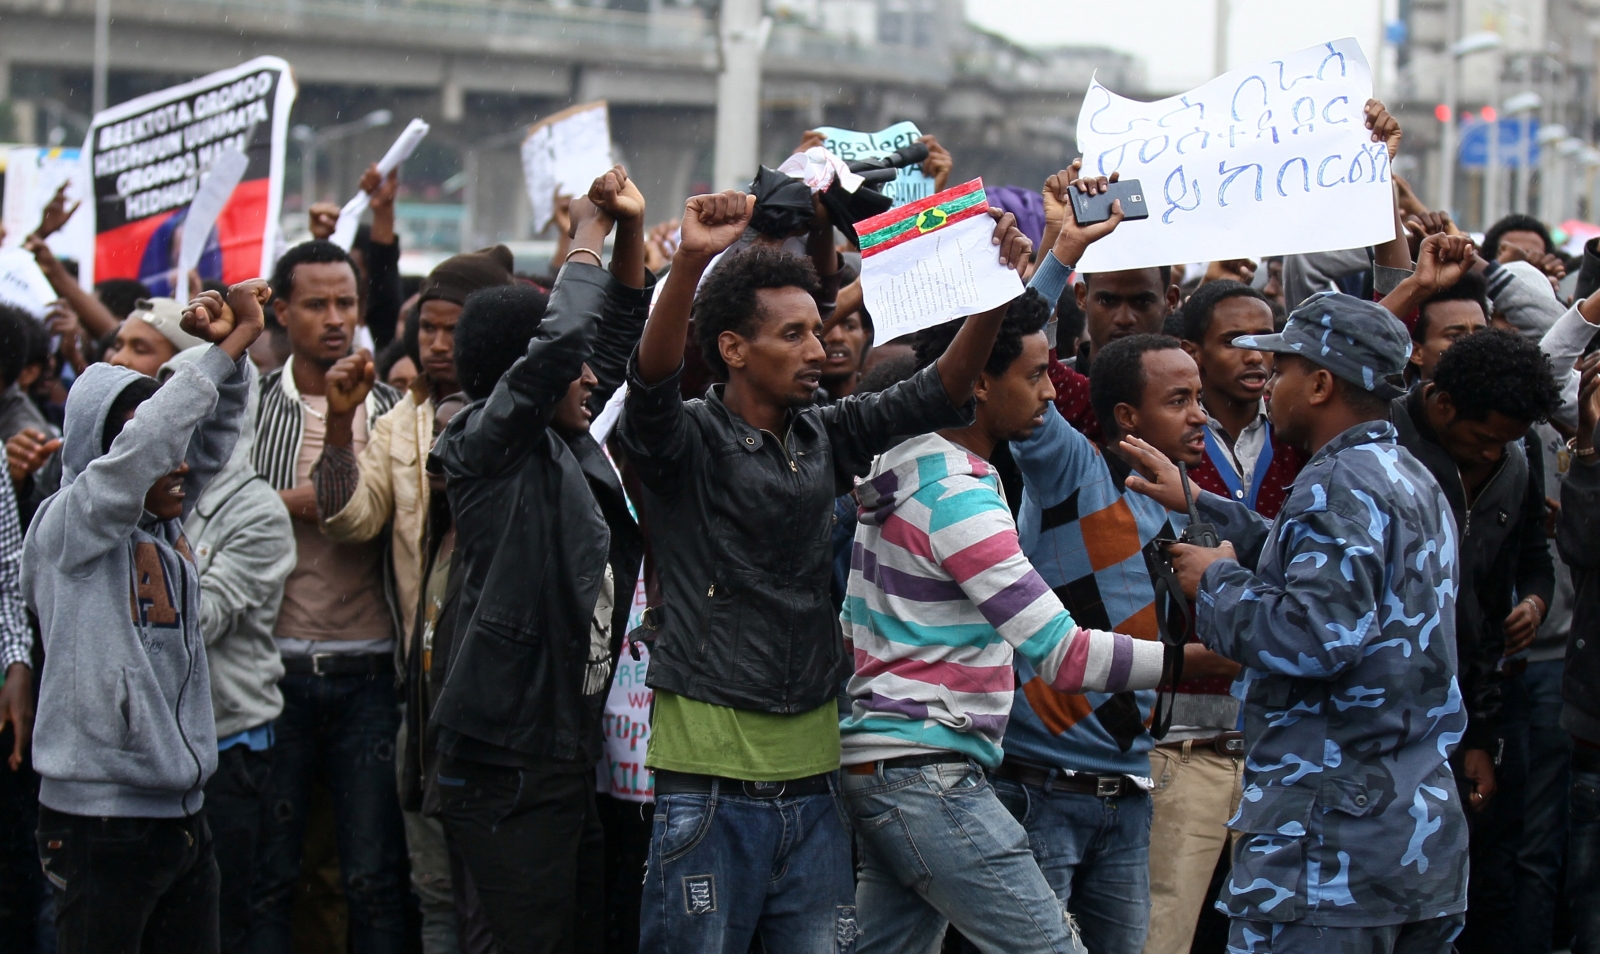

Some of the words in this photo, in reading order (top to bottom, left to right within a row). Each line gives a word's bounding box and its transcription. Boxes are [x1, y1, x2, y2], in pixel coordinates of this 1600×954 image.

[99, 101, 193, 152] BEEKTOTA
[193, 72, 272, 120] OROMOO
[614, 663, 647, 689] RE
[603, 713, 647, 752] TOP
